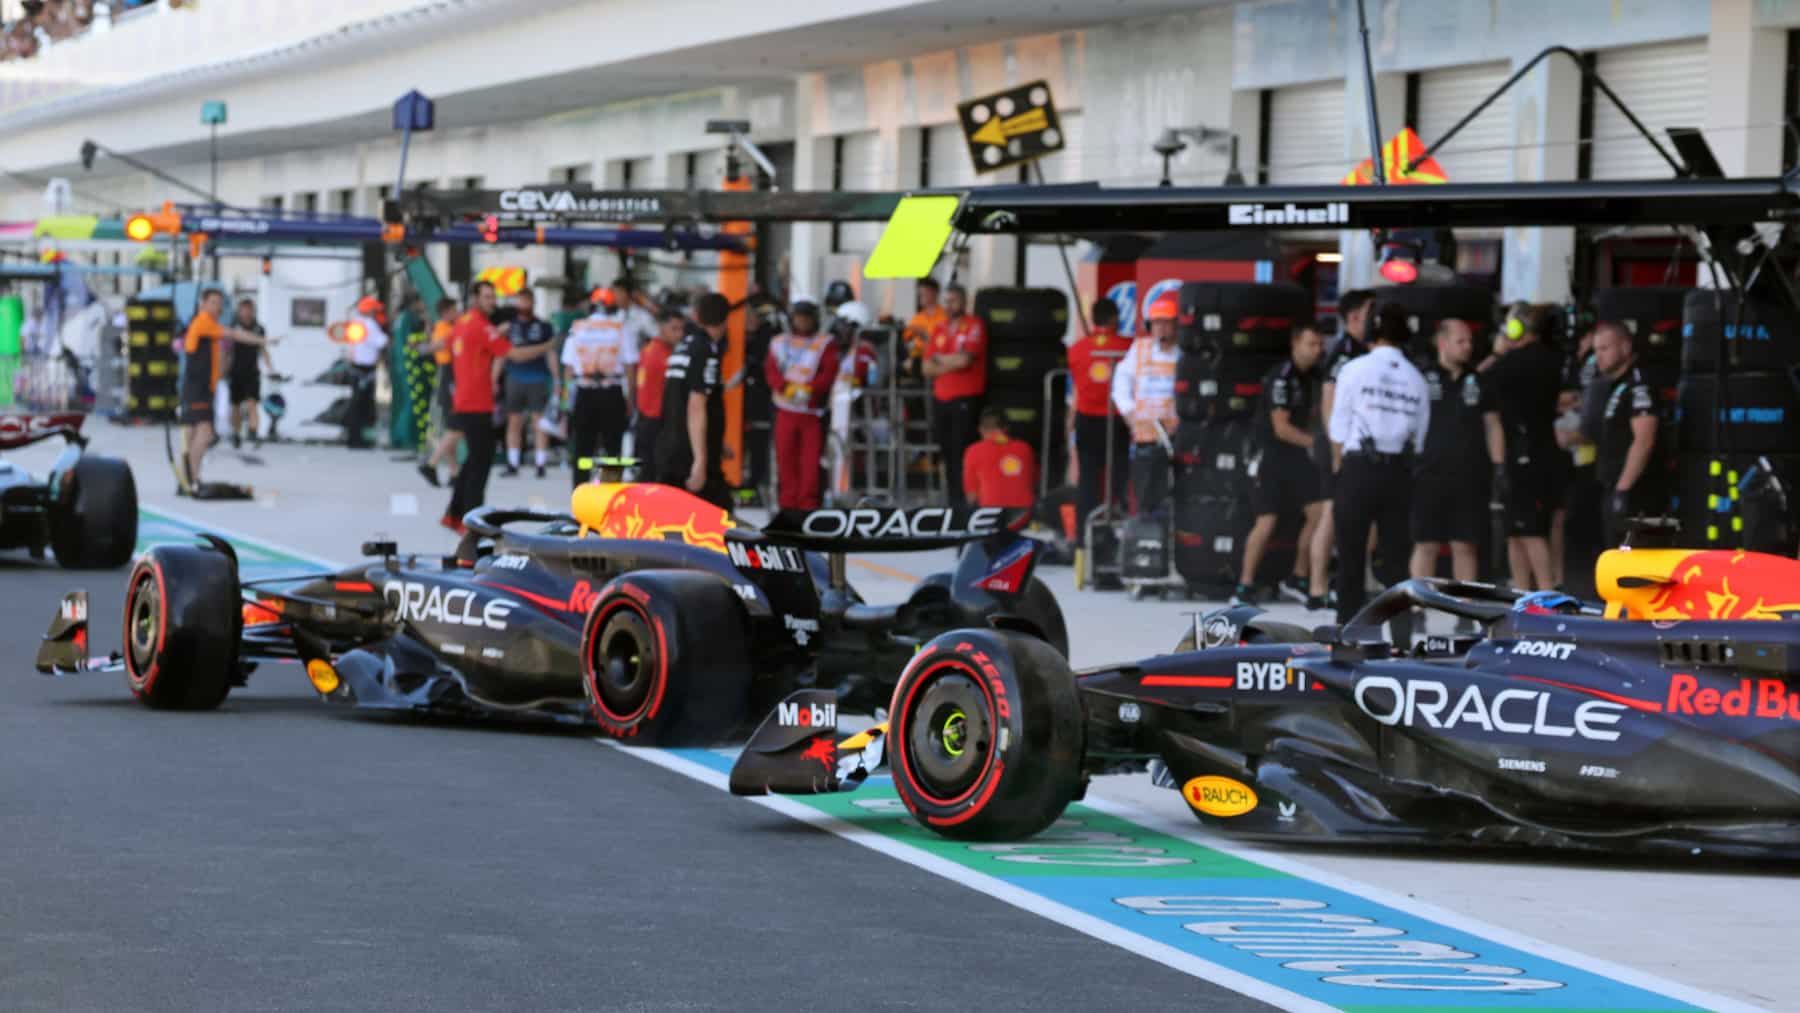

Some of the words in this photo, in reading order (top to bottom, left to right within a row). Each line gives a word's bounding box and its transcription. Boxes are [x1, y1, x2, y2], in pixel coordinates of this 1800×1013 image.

[578, 198, 660, 212] LOGISTICS
[1228, 203, 1349, 225] Einhell
[802, 508, 1003, 538] ORACLE
[727, 542, 784, 571] Mobil
[384, 580, 520, 630] ORACLE
[568, 580, 600, 613] Re
[971, 651, 1011, 719] ZERO
[1666, 673, 1752, 716] Red
[778, 702, 836, 727] Mobil
[1354, 676, 1629, 741] ORACLE
[1498, 758, 1546, 773] SIEMENS
[1202, 786, 1248, 807] RAUCH
